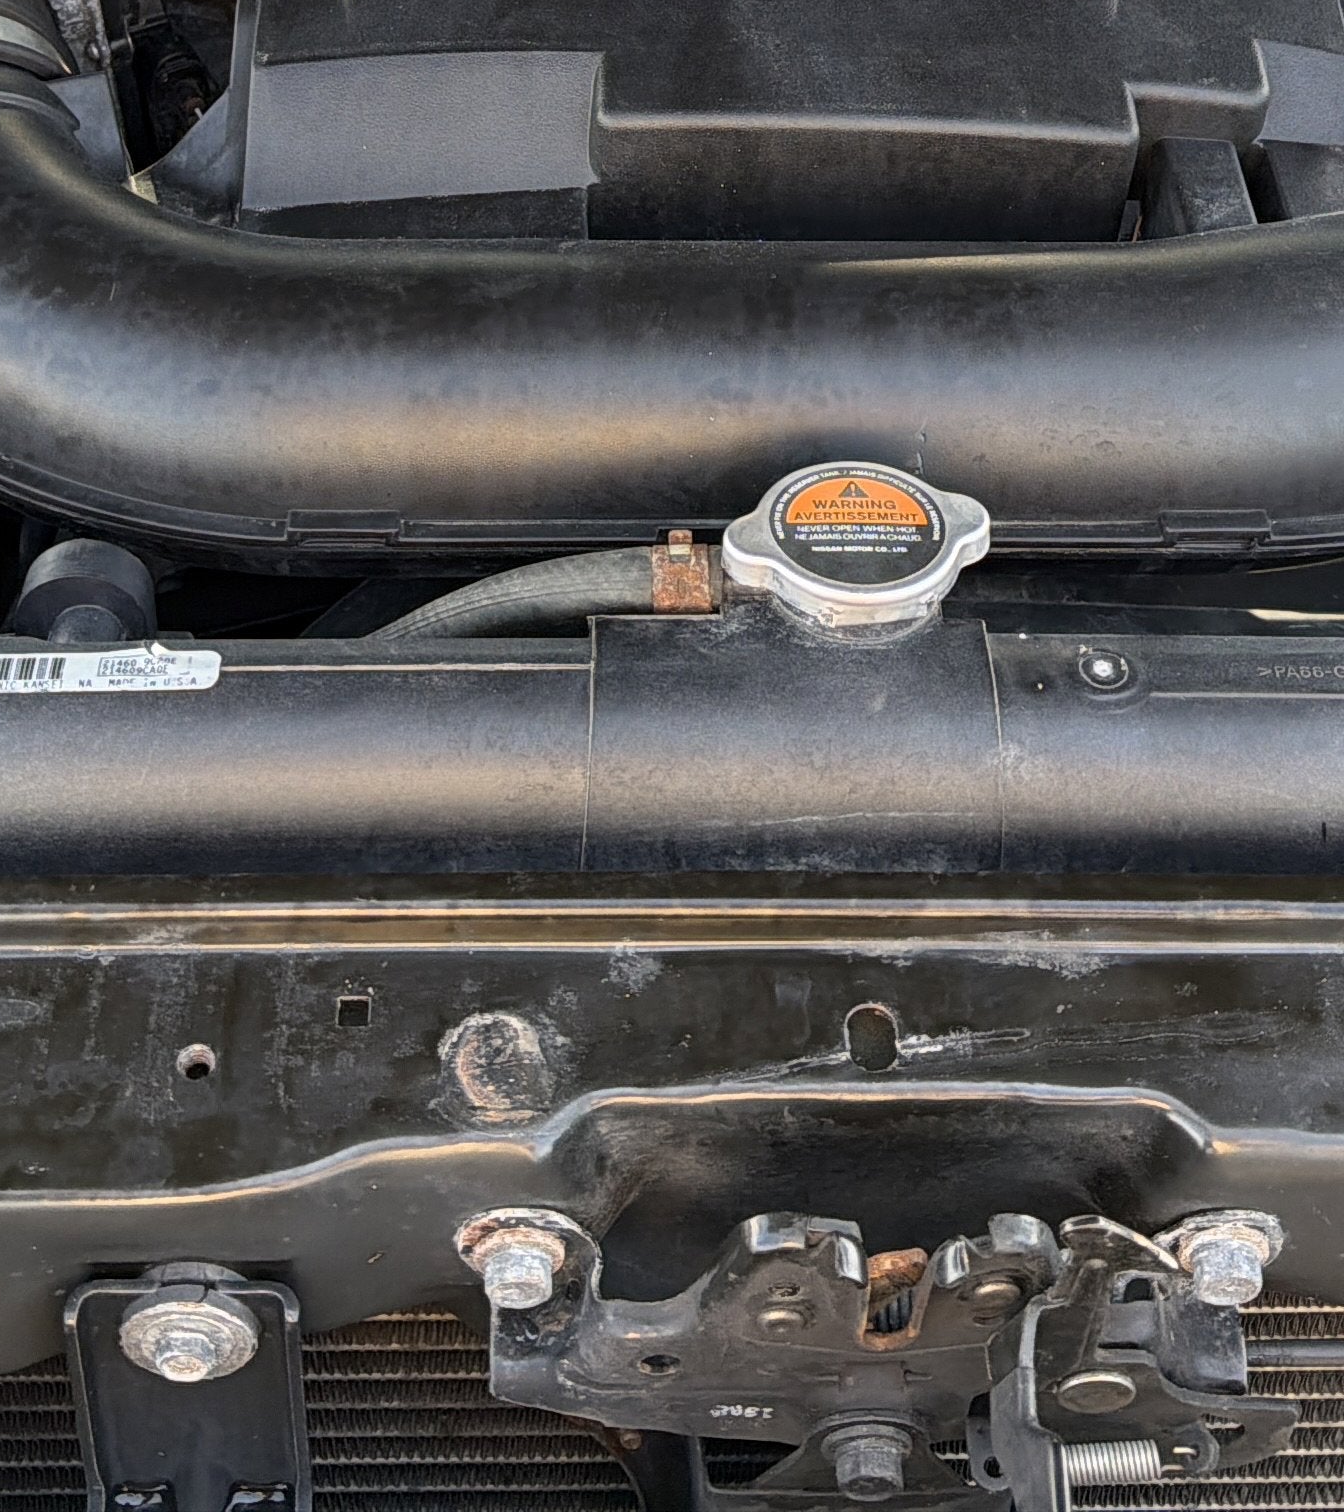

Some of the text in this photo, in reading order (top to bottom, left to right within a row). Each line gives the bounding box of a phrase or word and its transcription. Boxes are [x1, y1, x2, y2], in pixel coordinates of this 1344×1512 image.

[812, 499, 896, 510] WARNING
[794, 511, 919, 522] AVERTISSEMENT
[796, 525, 830, 533] NEVER
[831, 525, 860, 533] OPEN
[862, 525, 894, 533] WHEN
[794, 533, 807, 541] NE
[808, 533, 842, 541] JAMAIS
[842, 533, 878, 541] OUVRIR
[23, 679, 64, 689] KANSEI
[78, 679, 93, 688] NA
[107, 677, 137, 687] MADE
